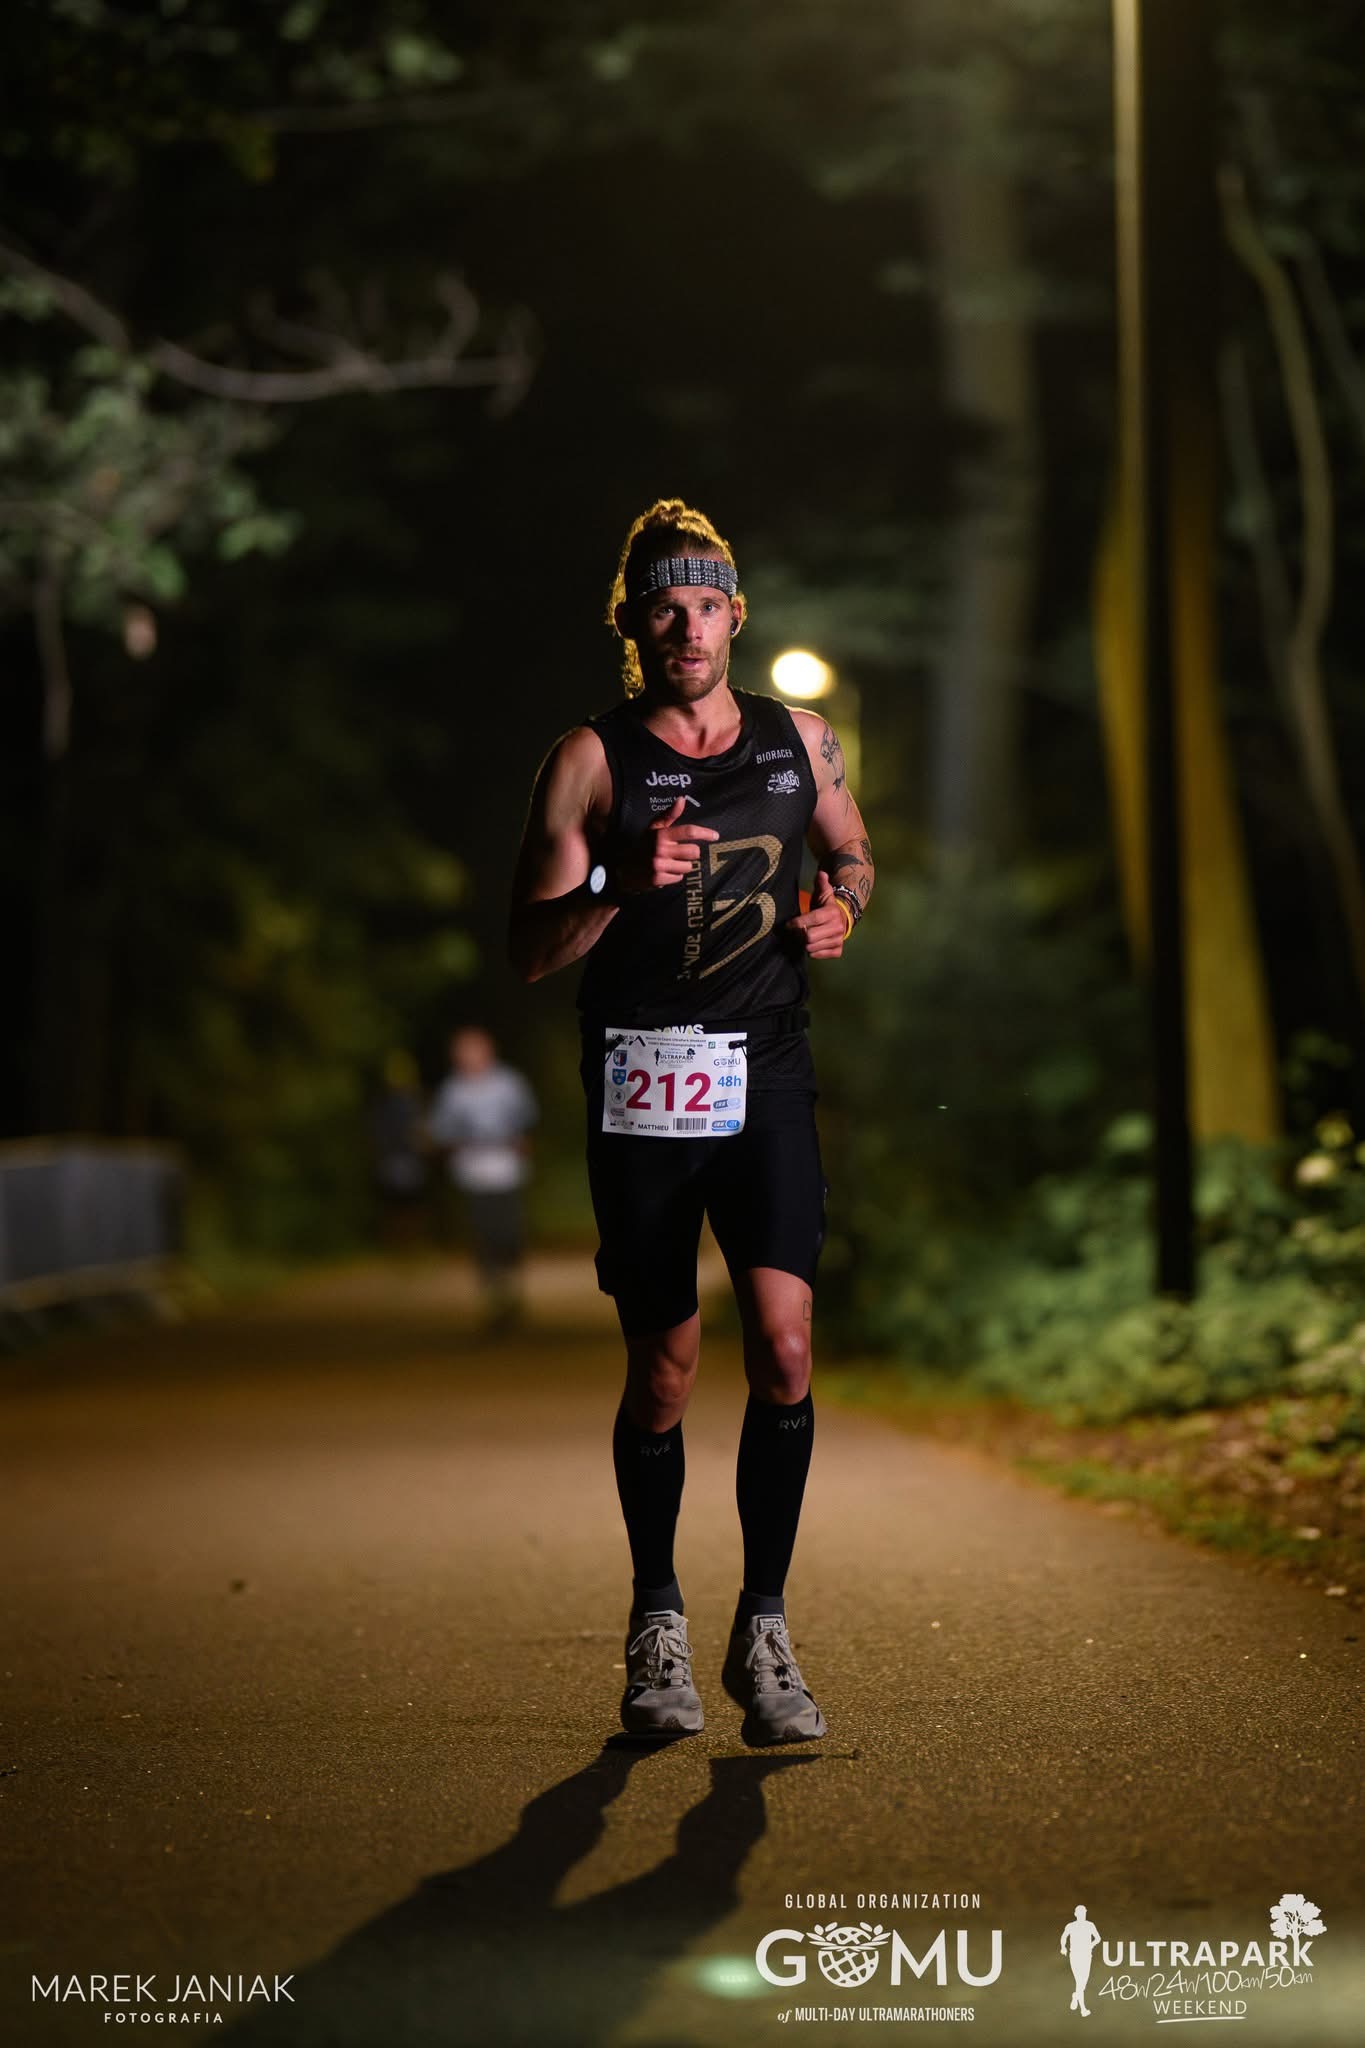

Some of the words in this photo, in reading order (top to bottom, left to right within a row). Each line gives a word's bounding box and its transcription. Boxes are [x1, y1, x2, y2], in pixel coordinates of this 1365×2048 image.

[756, 749, 794, 765] BIORACER
[645, 771, 692, 788] Jeep
[717, 1075, 742, 1087] 48h
[626, 1069, 711, 1112] 212
[637, 1123, 669, 1131] MATTHIEU
